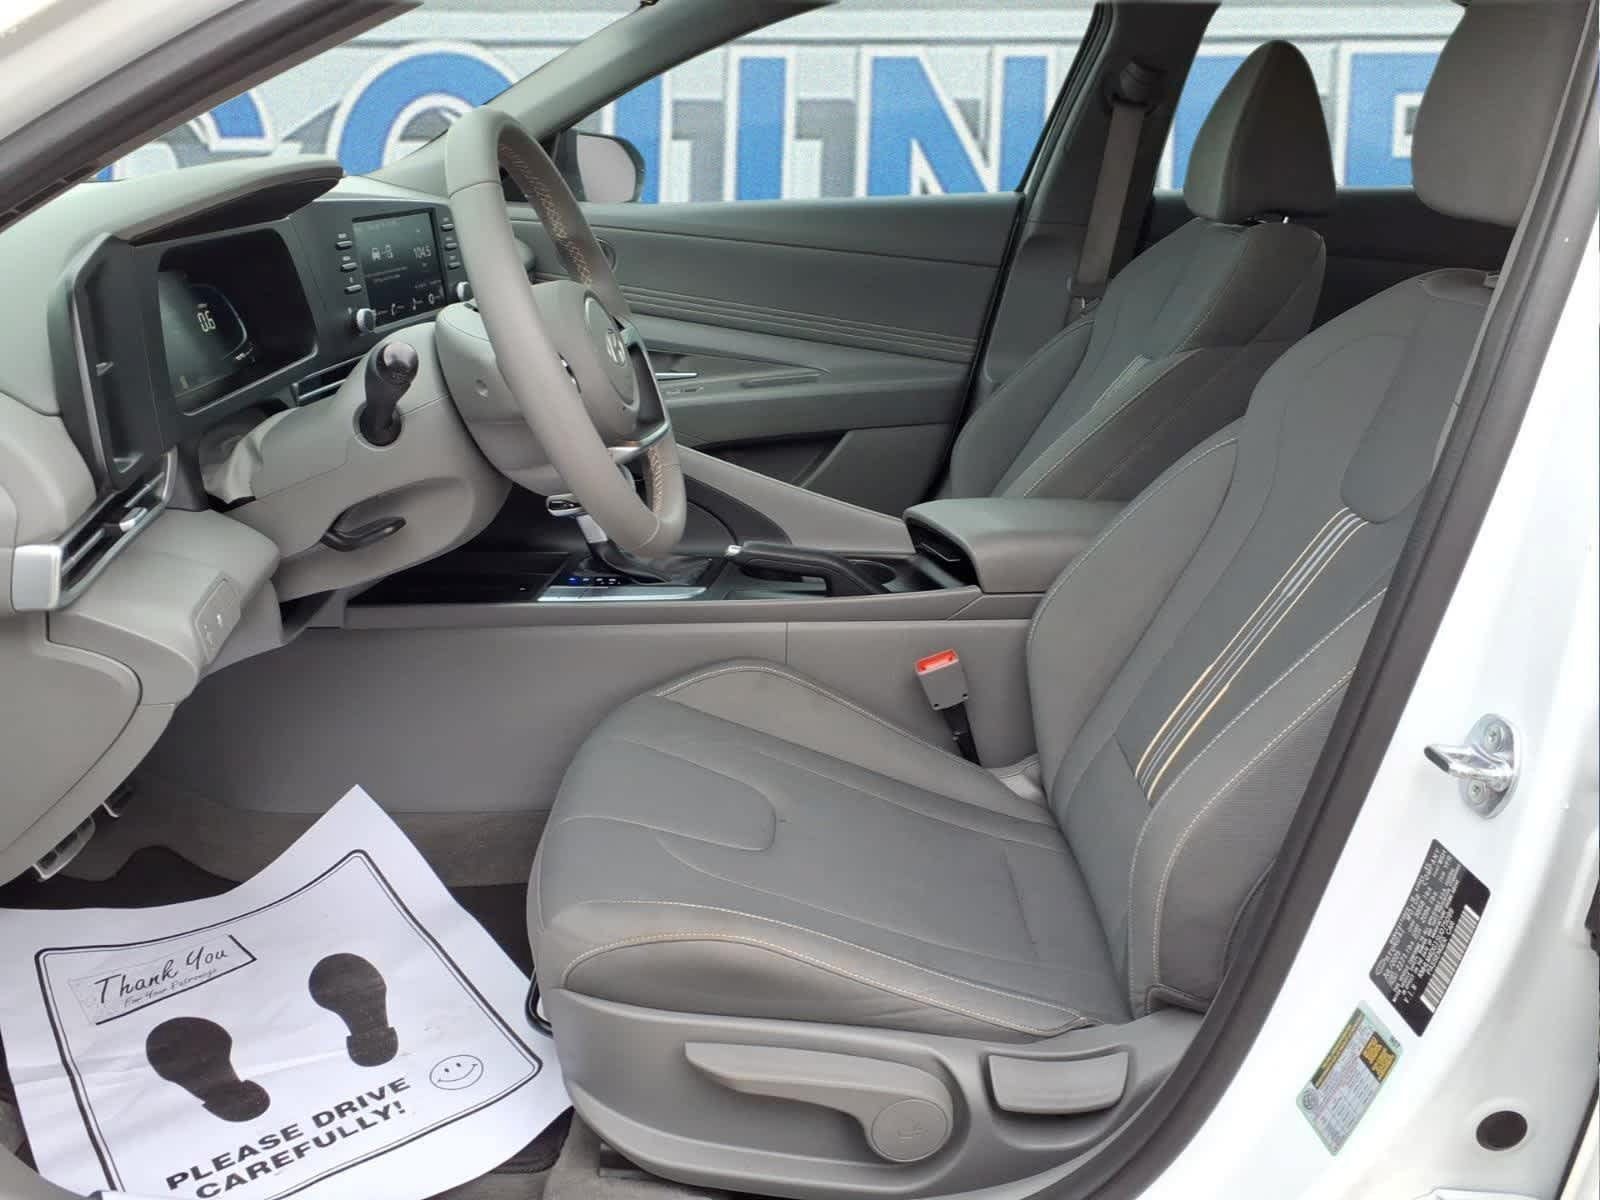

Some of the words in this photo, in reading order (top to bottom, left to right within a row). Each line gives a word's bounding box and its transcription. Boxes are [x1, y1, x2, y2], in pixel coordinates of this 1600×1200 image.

[94, 959, 179, 1004] Thank
[185, 946, 228, 970] You
[165, 1123, 304, 1190] PLEASE
[312, 1077, 411, 1128] DRIVE
[196, 1100, 407, 1199] CAREFULLY!
